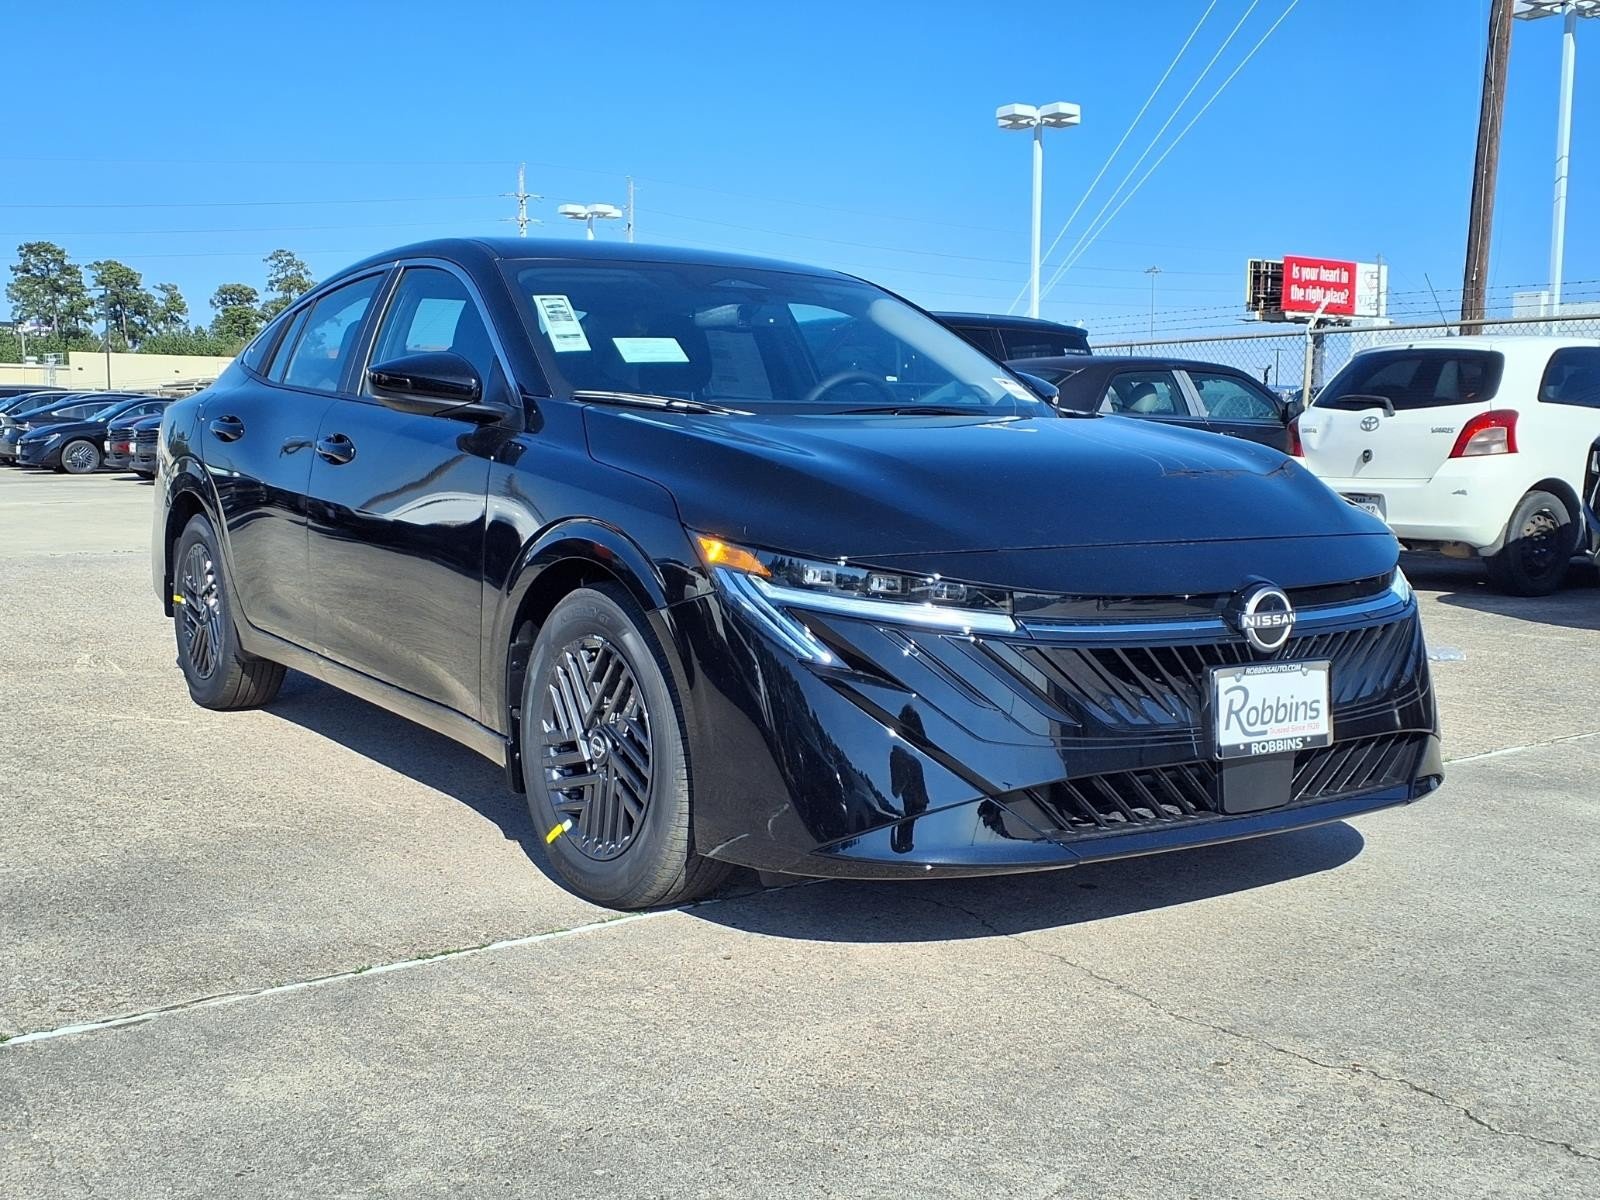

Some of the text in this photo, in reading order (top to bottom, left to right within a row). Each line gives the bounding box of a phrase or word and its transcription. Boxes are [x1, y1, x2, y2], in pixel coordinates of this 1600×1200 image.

[1292, 263, 1349, 284] Is your heart in
[1291, 284, 1304, 301] the
[1305, 285, 1324, 304] right
[1242, 612, 1296, 628] NISSAN
[1245, 663, 1302, 675] ROBBINSAUTO.COM
[1224, 685, 1320, 737] Robbins
[1251, 737, 1304, 755] ROBBINS
